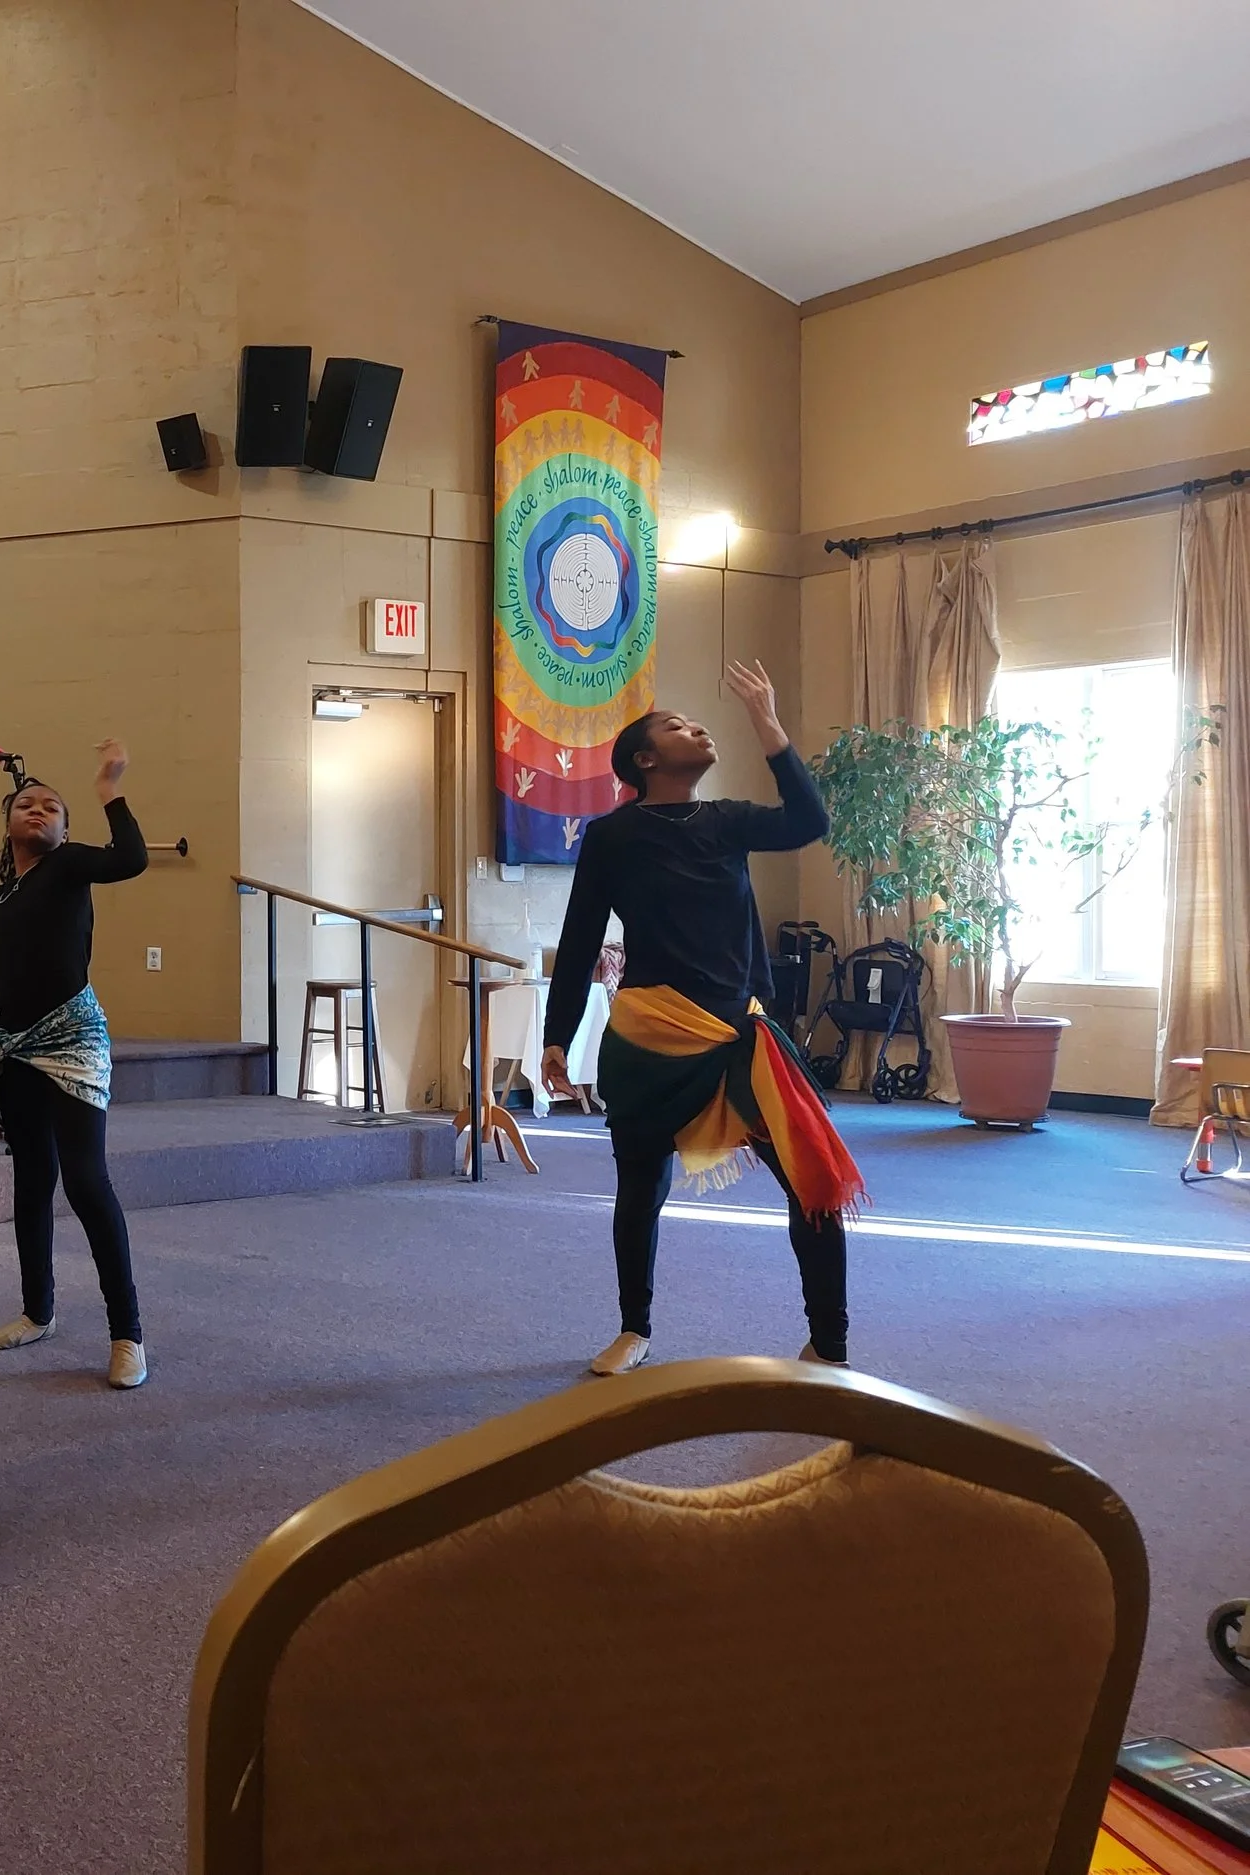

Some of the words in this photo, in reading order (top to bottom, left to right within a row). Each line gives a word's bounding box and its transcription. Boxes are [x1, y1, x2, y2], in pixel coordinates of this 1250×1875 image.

[543, 453, 598, 493] shalom
[601, 473, 642, 519] peace
[505, 493, 538, 550] peace
[638, 520, 658, 592] shalom
[385, 603, 418, 637] EXIT
[498, 566, 534, 640] shalom
[631, 597, 657, 653] peace
[537, 646, 575, 686] peace
